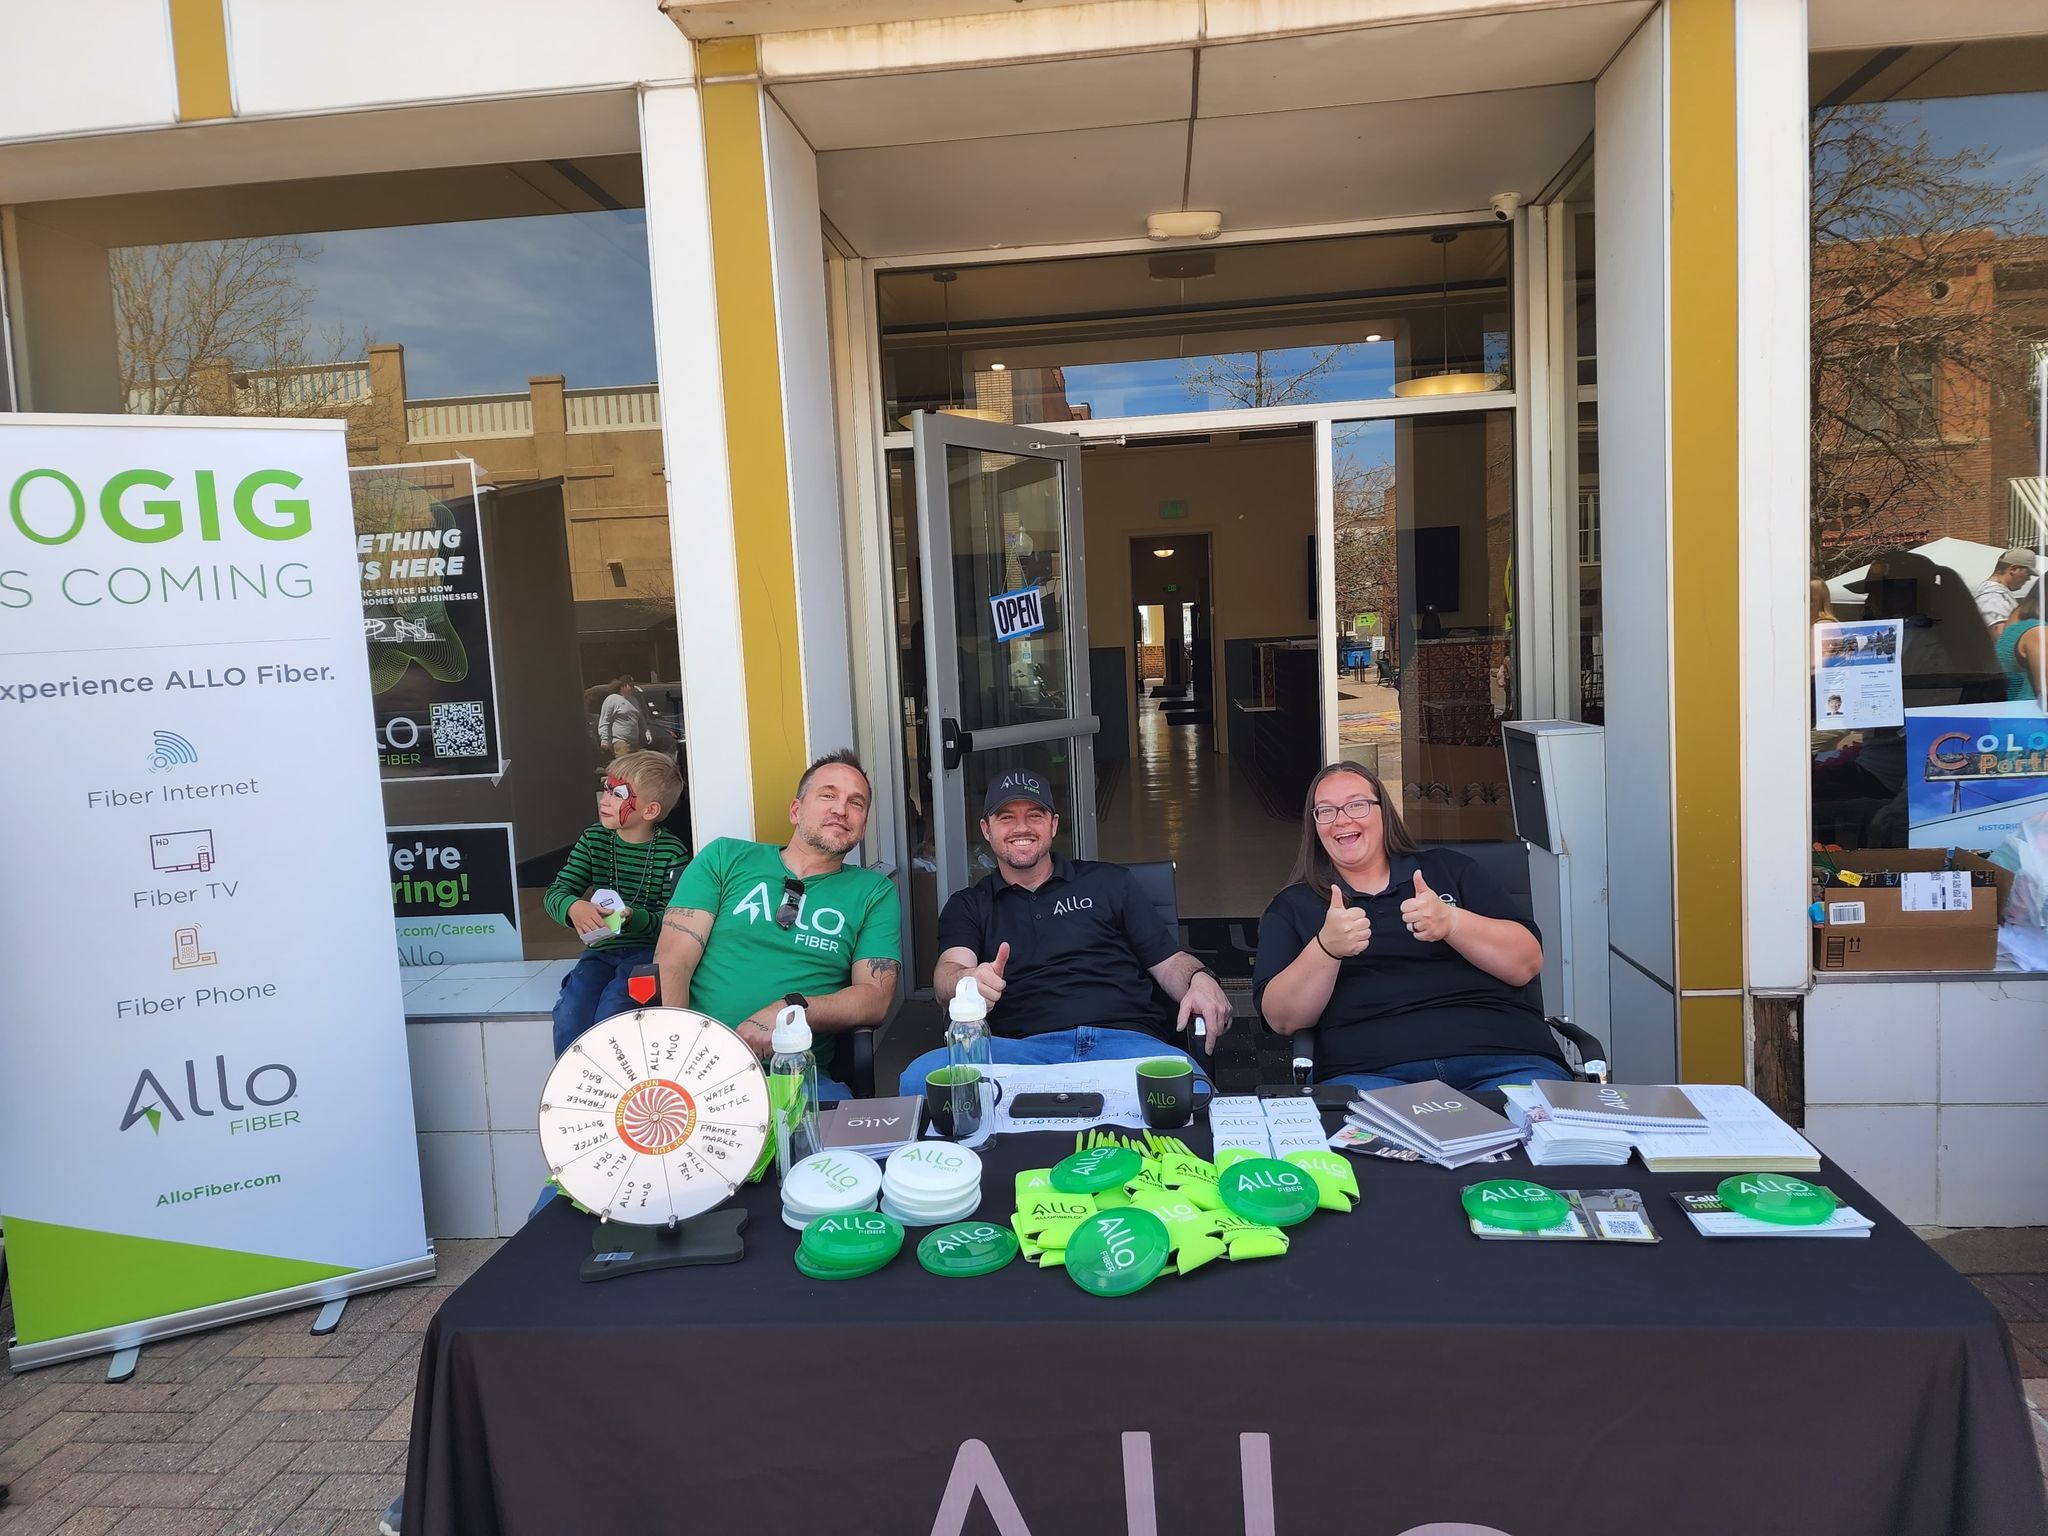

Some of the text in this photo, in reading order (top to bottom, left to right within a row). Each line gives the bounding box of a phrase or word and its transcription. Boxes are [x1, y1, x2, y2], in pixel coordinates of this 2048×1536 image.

[390, 555, 465, 579] HERE
[62, 562, 313, 606] COMING
[375, 587, 415, 597] SERVICE
[418, 586, 427, 594] IS
[429, 585, 453, 593] NOW
[362, 592, 479, 606] HOMES AND BUSINESSES
[996, 592, 1040, 635] OPEN
[0, 663, 336, 703] xperience ALLO Fiber.
[378, 753, 422, 766] FIBER
[88, 777, 260, 809] Fiber Internet
[155, 838, 169, 847] HD
[133, 880, 239, 909] Fiber TV
[794, 933, 839, 954] FIBER
[116, 980, 277, 1019] Fiber Phone
[650, 1041, 660, 1071] ALLO
[665, 1033, 680, 1060] MUG
[608, 1036, 638, 1082] NOTEBOOK
[685, 1046, 710, 1075] STICKY
[697, 1055, 720, 1080] NOTES
[582, 1069, 602, 1084] BAG
[576, 1082, 619, 1100] MARKET
[704, 1083, 736, 1102] WATER
[567, 1095, 607, 1109] FARMER
[616, 1080, 659, 1126] WHIRL OF FUN
[708, 1094, 750, 1113] BOTTLE
[230, 1110, 302, 1136] FIBER
[558, 1120, 604, 1135] BOTTLE
[699, 1124, 737, 1136] FARMER
[573, 1132, 609, 1151] WATER
[652, 1146, 672, 1155] FUN
[702, 1135, 743, 1149] MARKET
[707, 1144, 726, 1160] Bag
[593, 1151, 613, 1170] PEN
[607, 1153, 627, 1178] ALLO
[686, 1151, 704, 1173] ALLO
[678, 1162, 693, 1181] PEN
[156, 1174, 282, 1207] AlloFiber.com
[620, 1181, 635, 1208] ALLO
[640, 1182, 652, 1208] MUG
[1277, 1185, 1304, 1193] FIBER
[976, 1232, 1003, 1244] FIBER
[1100, 1250, 1116, 1274] FIBER
